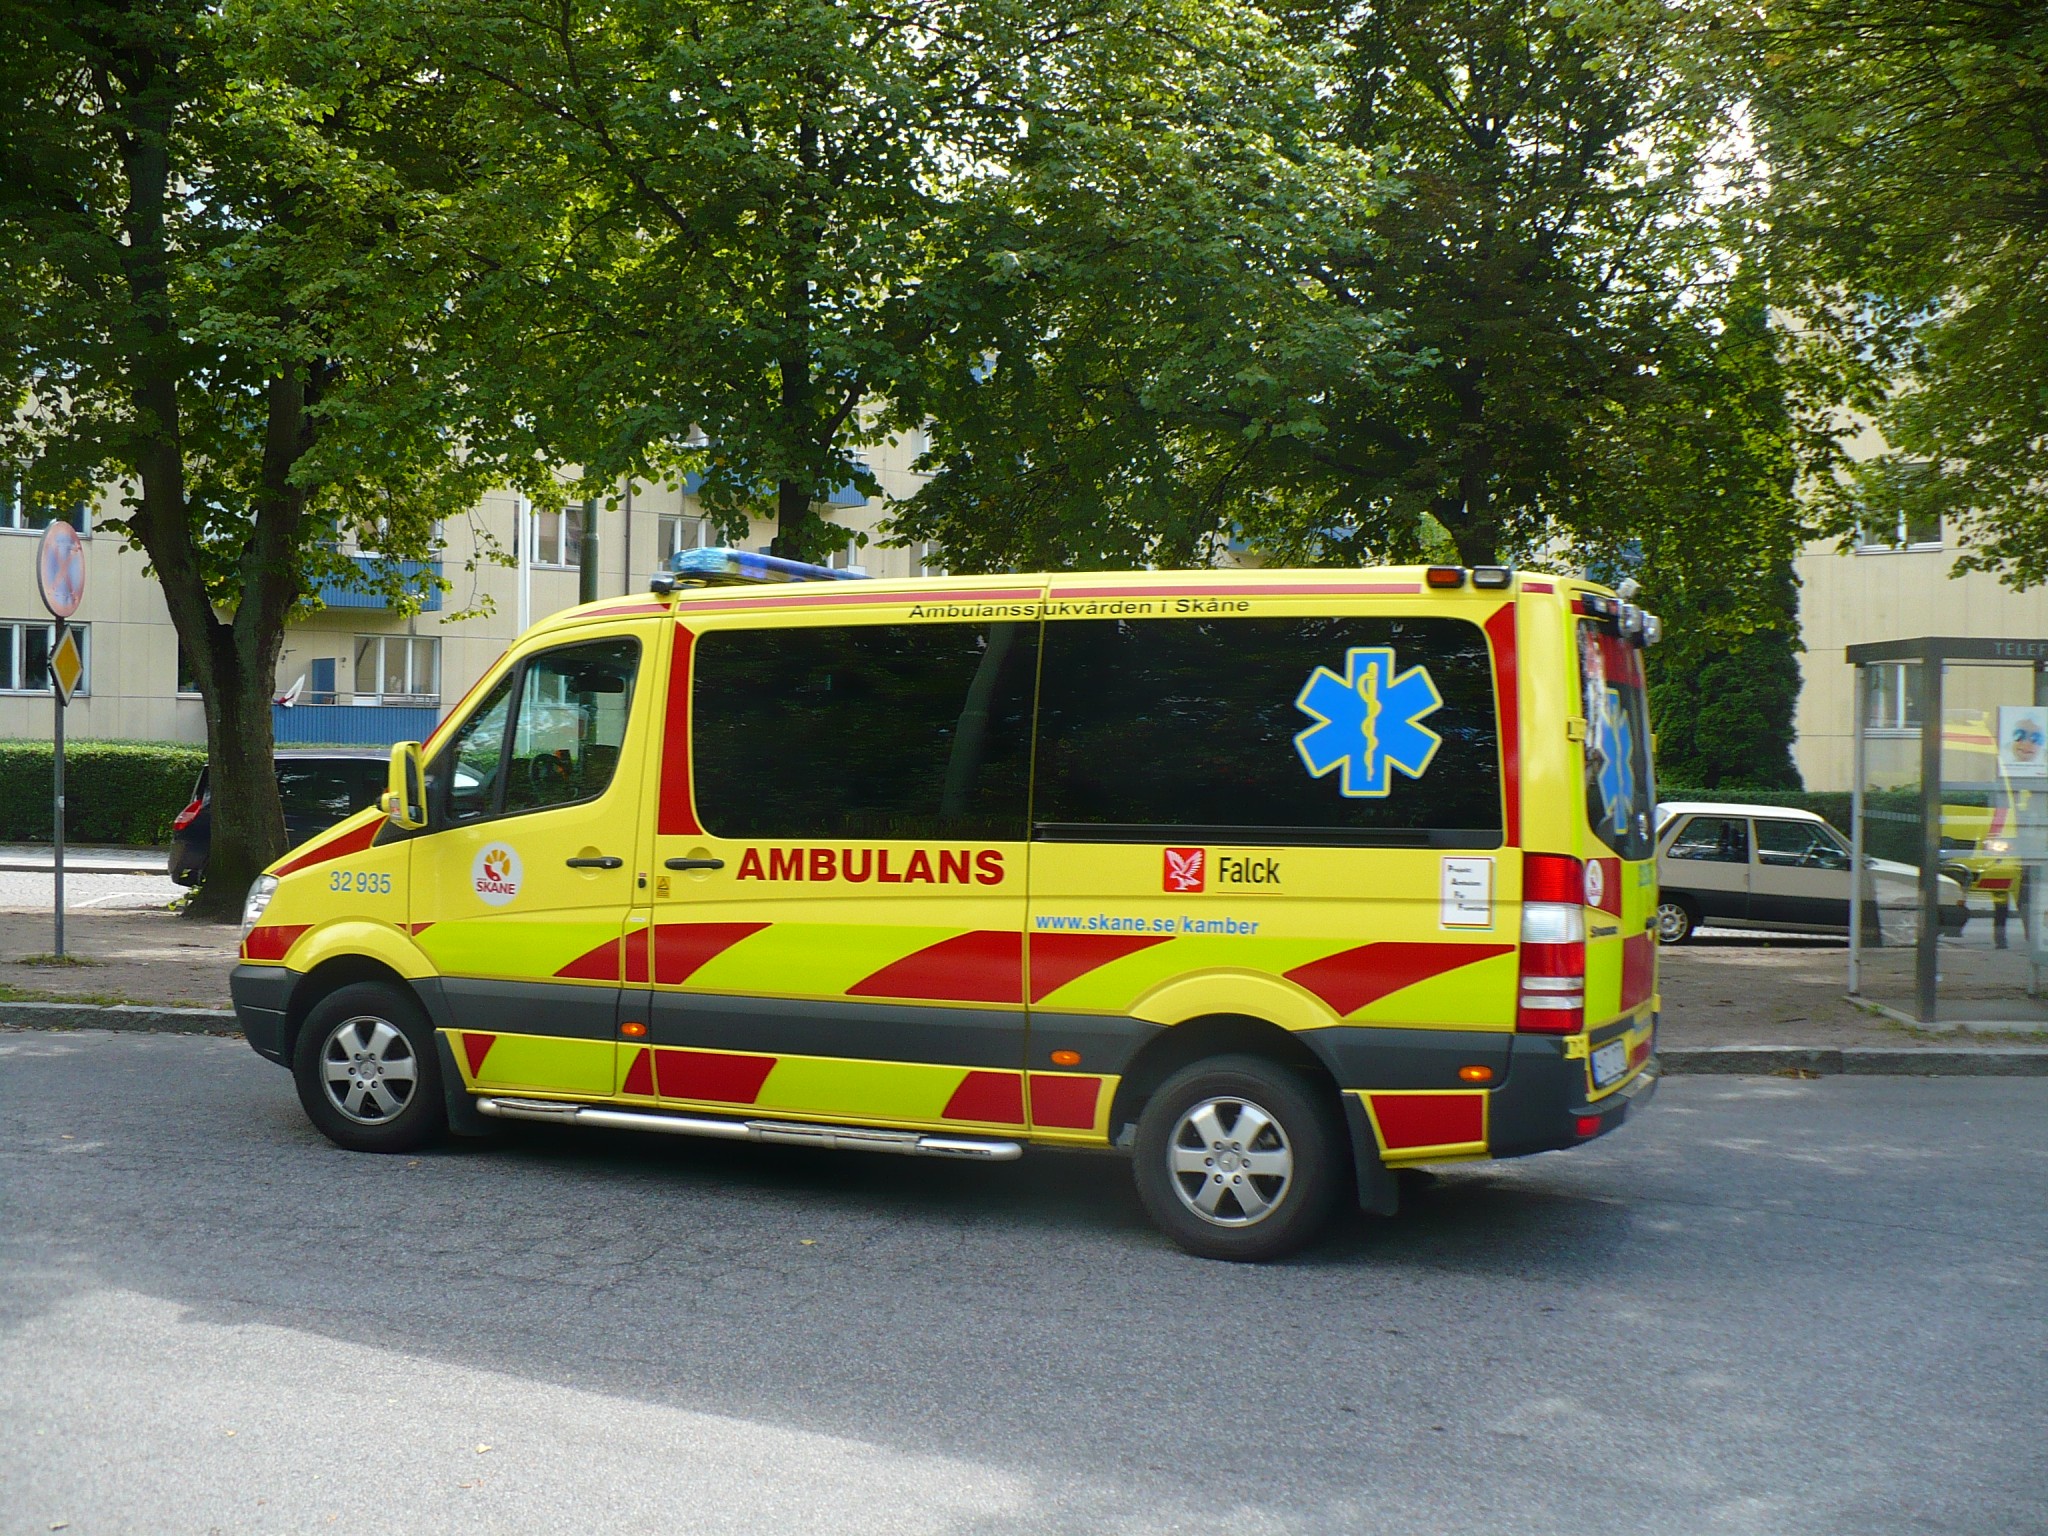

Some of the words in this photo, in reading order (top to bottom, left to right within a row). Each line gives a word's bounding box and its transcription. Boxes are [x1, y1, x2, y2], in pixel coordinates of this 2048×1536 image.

[909, 600, 1152, 620] Ambulanssjukvården
[1161, 600, 1167, 613] i
[1175, 597, 1250, 613] Skåne
[736, 847, 1005, 885] AMBULANS
[1218, 857, 1281, 884] Falck
[330, 871, 352, 891] 32
[356, 872, 391, 894] 935
[1035, 914, 1259, 935] www.skane.se/kamber
